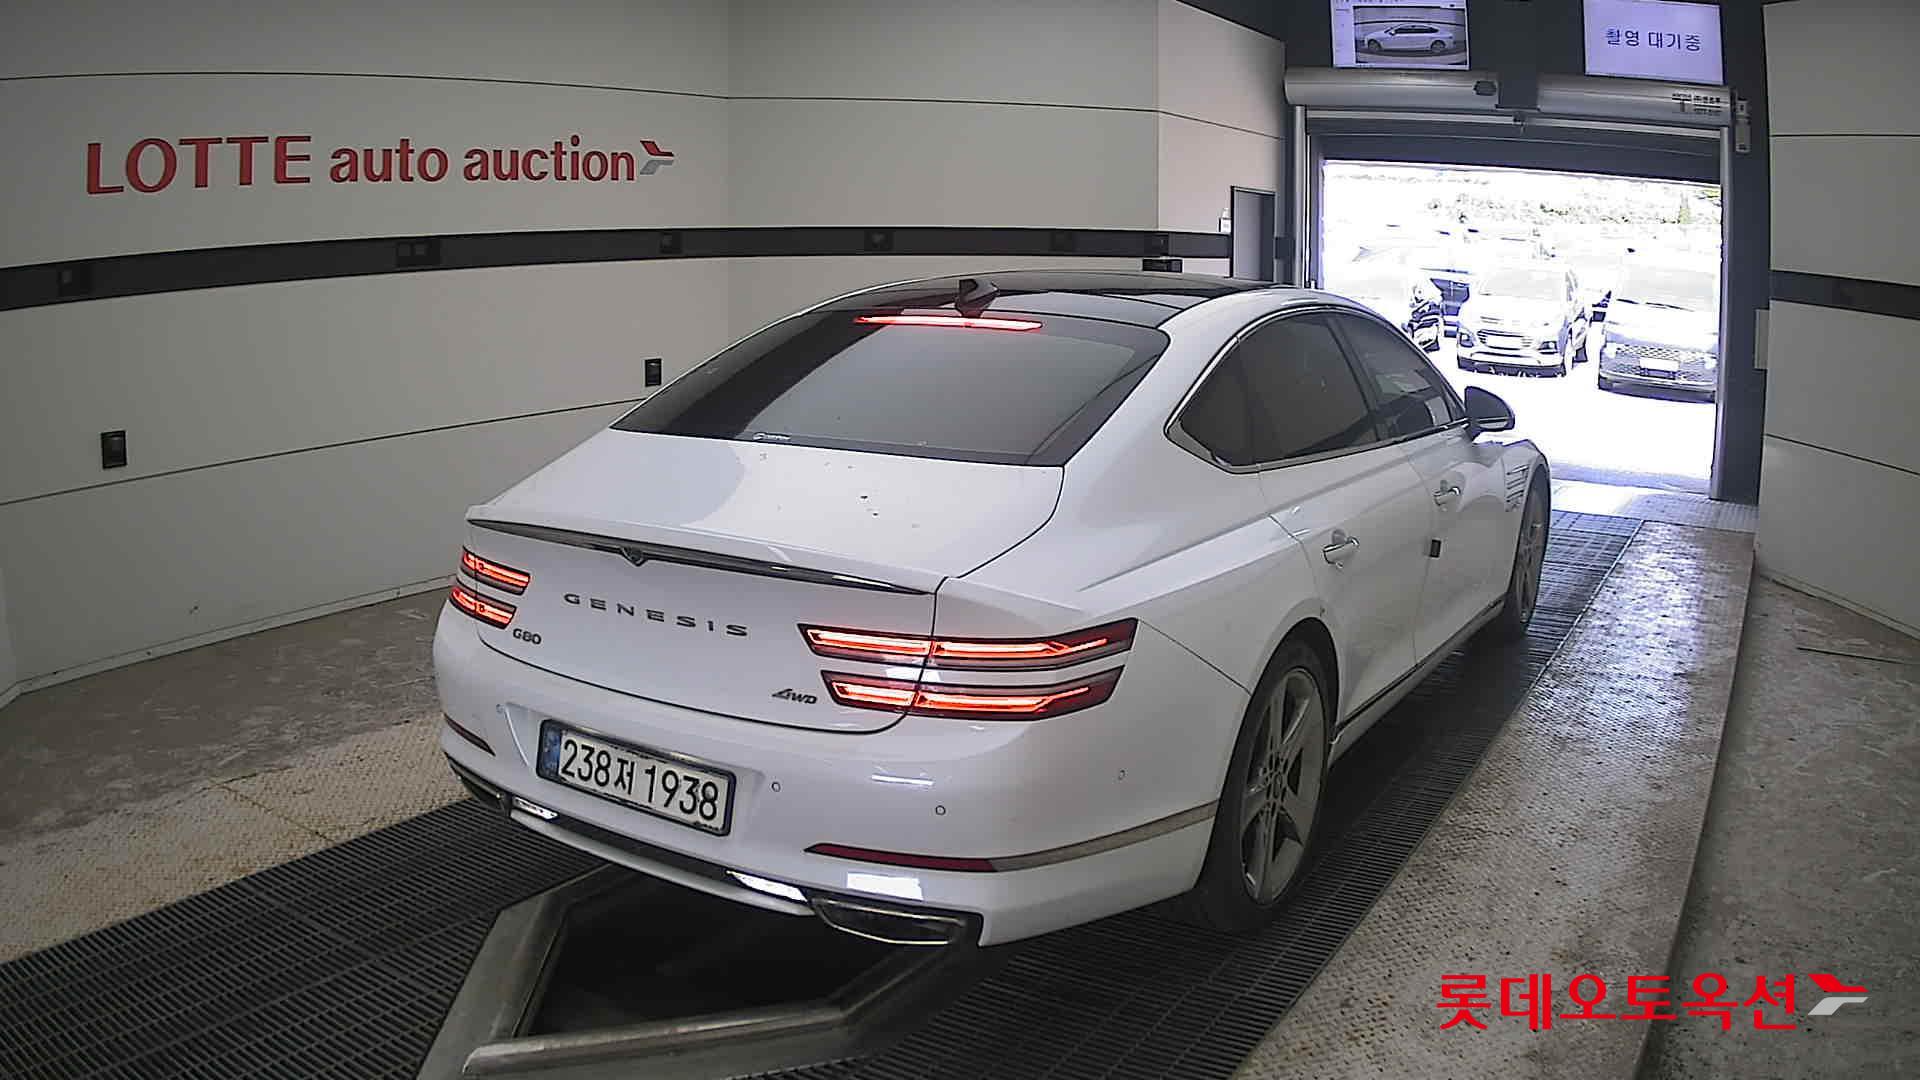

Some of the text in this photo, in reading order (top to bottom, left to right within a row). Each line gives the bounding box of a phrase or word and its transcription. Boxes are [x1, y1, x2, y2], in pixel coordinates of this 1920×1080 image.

[87, 134, 635, 195] LOTTE auto auction
[563, 593, 748, 637] GENESIS
[512, 628, 542, 645] G80
[771, 688, 817, 704] 4WD
